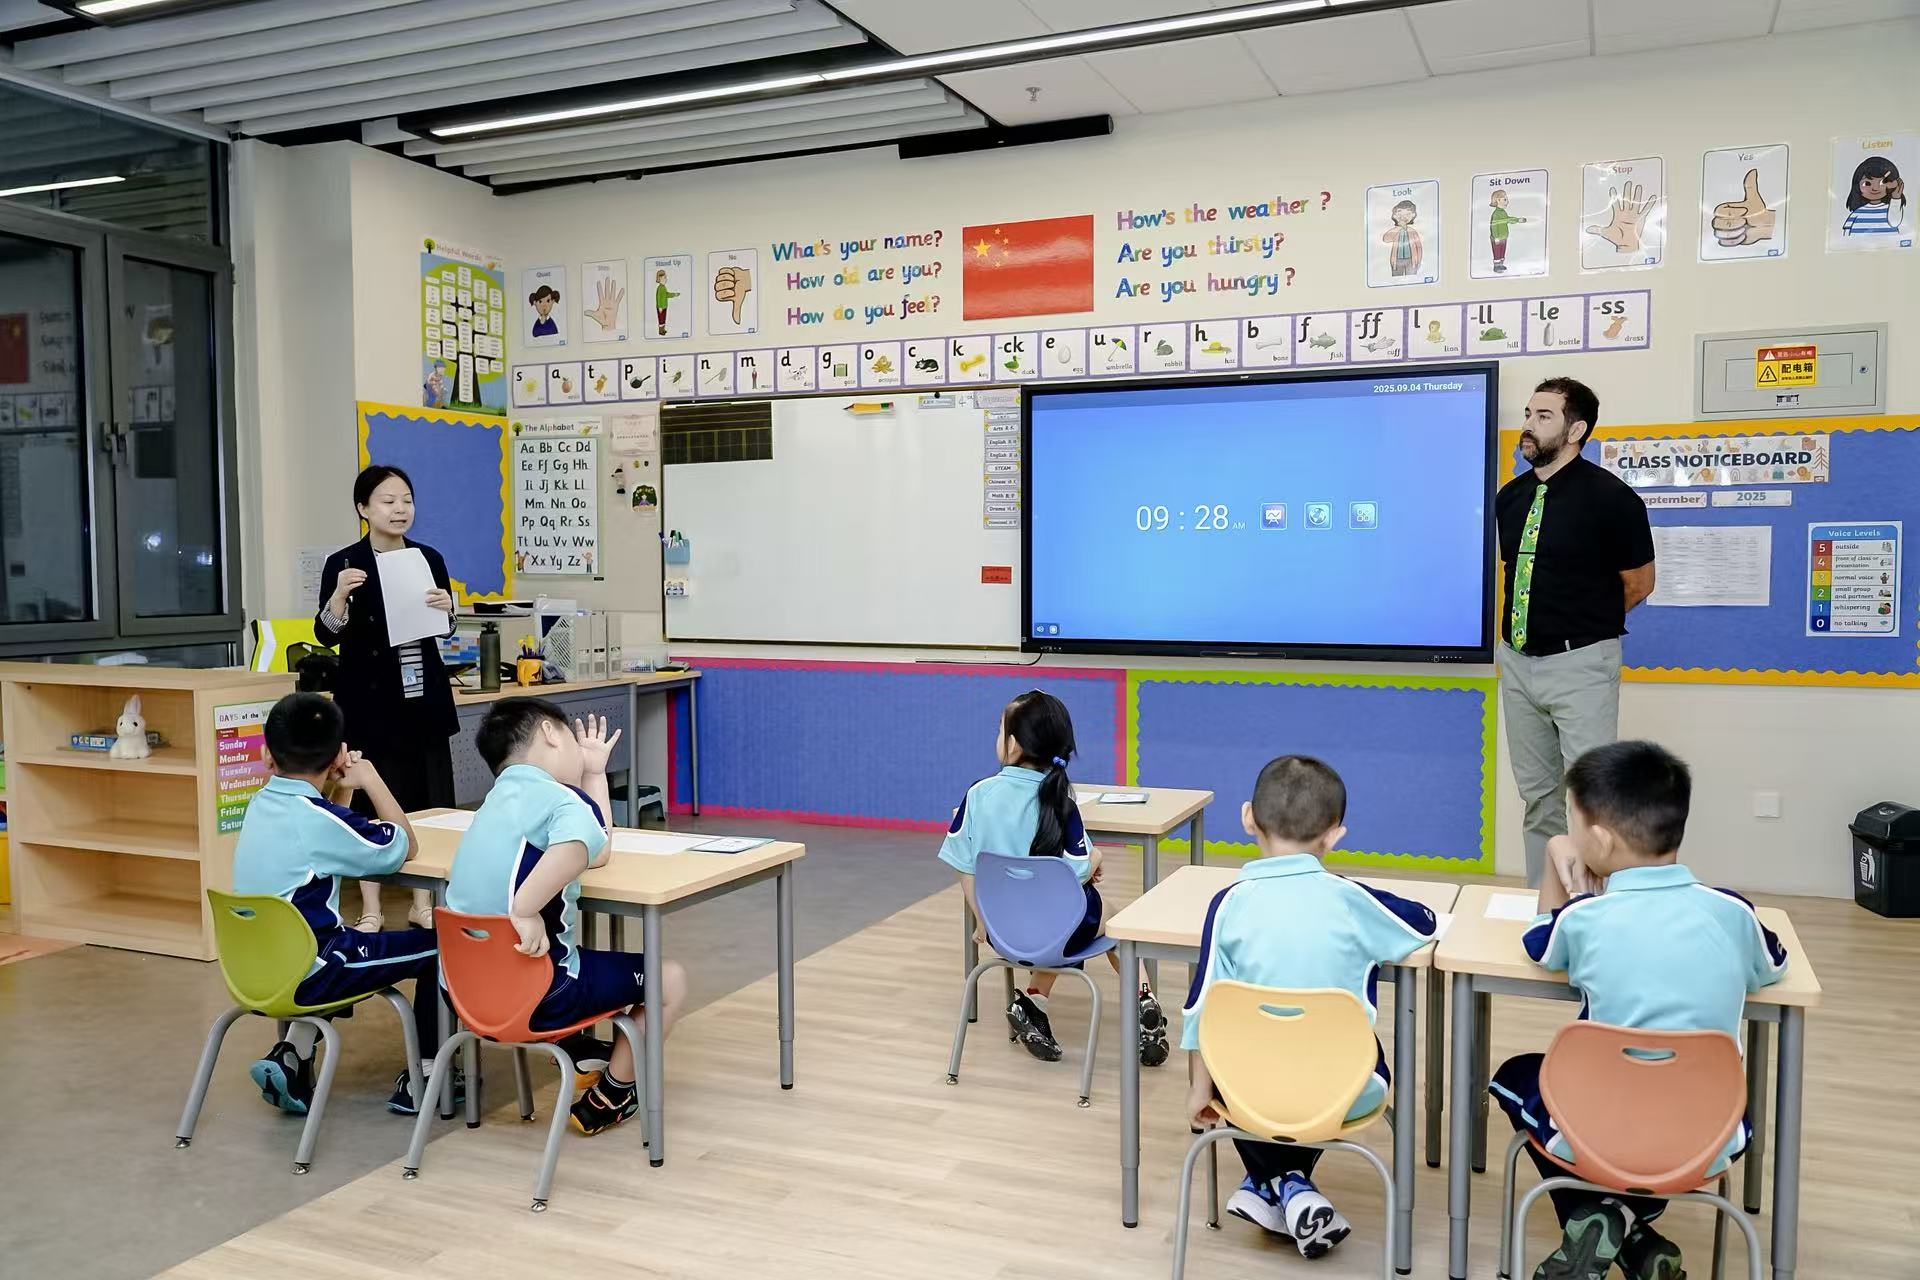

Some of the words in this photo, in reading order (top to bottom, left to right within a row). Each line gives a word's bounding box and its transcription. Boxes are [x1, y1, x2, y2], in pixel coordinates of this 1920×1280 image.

[1862, 139, 1893, 149] Listen
[1738, 153, 1754, 162] Yes
[1612, 165, 1633, 175] Stop
[1489, 177, 1502, 187] Sit
[1504, 176, 1530, 185] Down
[1392, 187, 1412, 197] Look
[1117, 208, 1176, 231] How's
[1184, 203, 1217, 223] the
[1228, 196, 1309, 220] weather
[772, 238, 831, 262] What's
[840, 238, 877, 261] your
[884, 229, 943, 249] name?
[1117, 242, 1152, 263] Are
[1161, 244, 1197, 268] you
[1207, 232, 1285, 259] thirsty?
[672, 258, 681, 266] Up
[787, 272, 825, 291] How
[833, 266, 860, 286] old
[867, 267, 895, 281] are
[902, 261, 942, 285] you?
[1115, 277, 1150, 298] Are
[1161, 279, 1196, 303] you
[1207, 272, 1279, 297] hungry
[787, 307, 825, 326] How
[833, 303, 855, 321] do
[864, 304, 894, 325] you
[516, 371, 523, 382] s
[552, 369, 561, 379] a
[587, 365, 595, 379] t
[624, 364, 634, 380] p
[662, 359, 668, 373] i
[701, 359, 711, 370] n
[741, 356, 756, 367] m
[781, 351, 792, 366] d
[822, 351, 832, 369] g
[864, 349, 874, 360] o
[908, 346, 917, 358] c
[953, 340, 964, 357] k
[998, 335, 1025, 353] -ck
[1046, 336, 1055, 349] e
[1094, 334, 1106, 346] u
[1144, 330, 1152, 343] r
[1195, 324, 1208, 342] h
[1247, 320, 1259, 339] b
[1298, 316, 1312, 343] f
[1354, 312, 1384, 340] -ff
[1414, 309, 1421, 329] l
[1470, 304, 1495, 325] -ll
[1530, 301, 1560, 321] -le
[1592, 300, 1625, 315] -ss
[1105, 362, 1133, 371] umbrella
[1329, 351, 1344, 361] fish
[1506, 341, 1519, 349] hill
[1558, 337, 1581, 346] bottle
[1781, 362, 1813, 374] 配电箱
[1373, 383, 1421, 393] 2025.09.04
[1422, 381, 1463, 391] Thursday
[525, 424, 538, 432] The
[540, 423, 575, 432] Alphabet
[520, 442, 534, 453] Aa
[540, 442, 553, 453] Bb
[558, 441, 571, 453] Cc
[576, 441, 591, 452] Dd
[1617, 455, 1671, 469] CLASS
[1675, 451, 1812, 469] NOTICEBOARD
[521, 460, 533, 471] Ee
[538, 459, 548, 474] Ff
[553, 459, 569, 474] Gg
[573, 458, 588, 470] Hh
[525, 480, 533, 490] Ii
[539, 479, 549, 493] Jj
[554, 479, 569, 490] Kk
[574, 478, 584, 490] Ll
[1643, 495, 1701, 506] eptember
[1736, 491, 1766, 502] 2025
[525, 498, 545, 509] Mm
[551, 498, 566, 509] Nn
[571, 497, 586, 508] Oo
[522, 516, 535, 530] Pp
[540, 515, 555, 530] Qq
[560, 515, 572, 527] Rr
[578, 515, 590, 527] Ss
[1232, 521, 1246, 531] AM
[517, 536, 528, 547] Tt
[534, 536, 549, 547] Uu
[553, 536, 567, 547] Vv
[572, 536, 594, 547] Ww
[1819, 543, 1826, 553] 5
[531, 555, 546, 566] Xx
[549, 554, 562, 570] Yy
[567, 555, 580, 566] Zz
[1818, 558, 1825, 567] 4
[1818, 588, 1825, 598] 2
[1818, 604, 1823, 613] 1
[1834, 604, 1871, 612] whispering
[1816, 619, 1824, 628] 0
[219, 713, 239, 722] DAYS
[219, 740, 248, 751] Sunday
[219, 753, 249, 764] Monday
[220, 766, 252, 777] Tuesday
[220, 776, 264, 791] Wednesday
[220, 806, 245, 817] Friday
